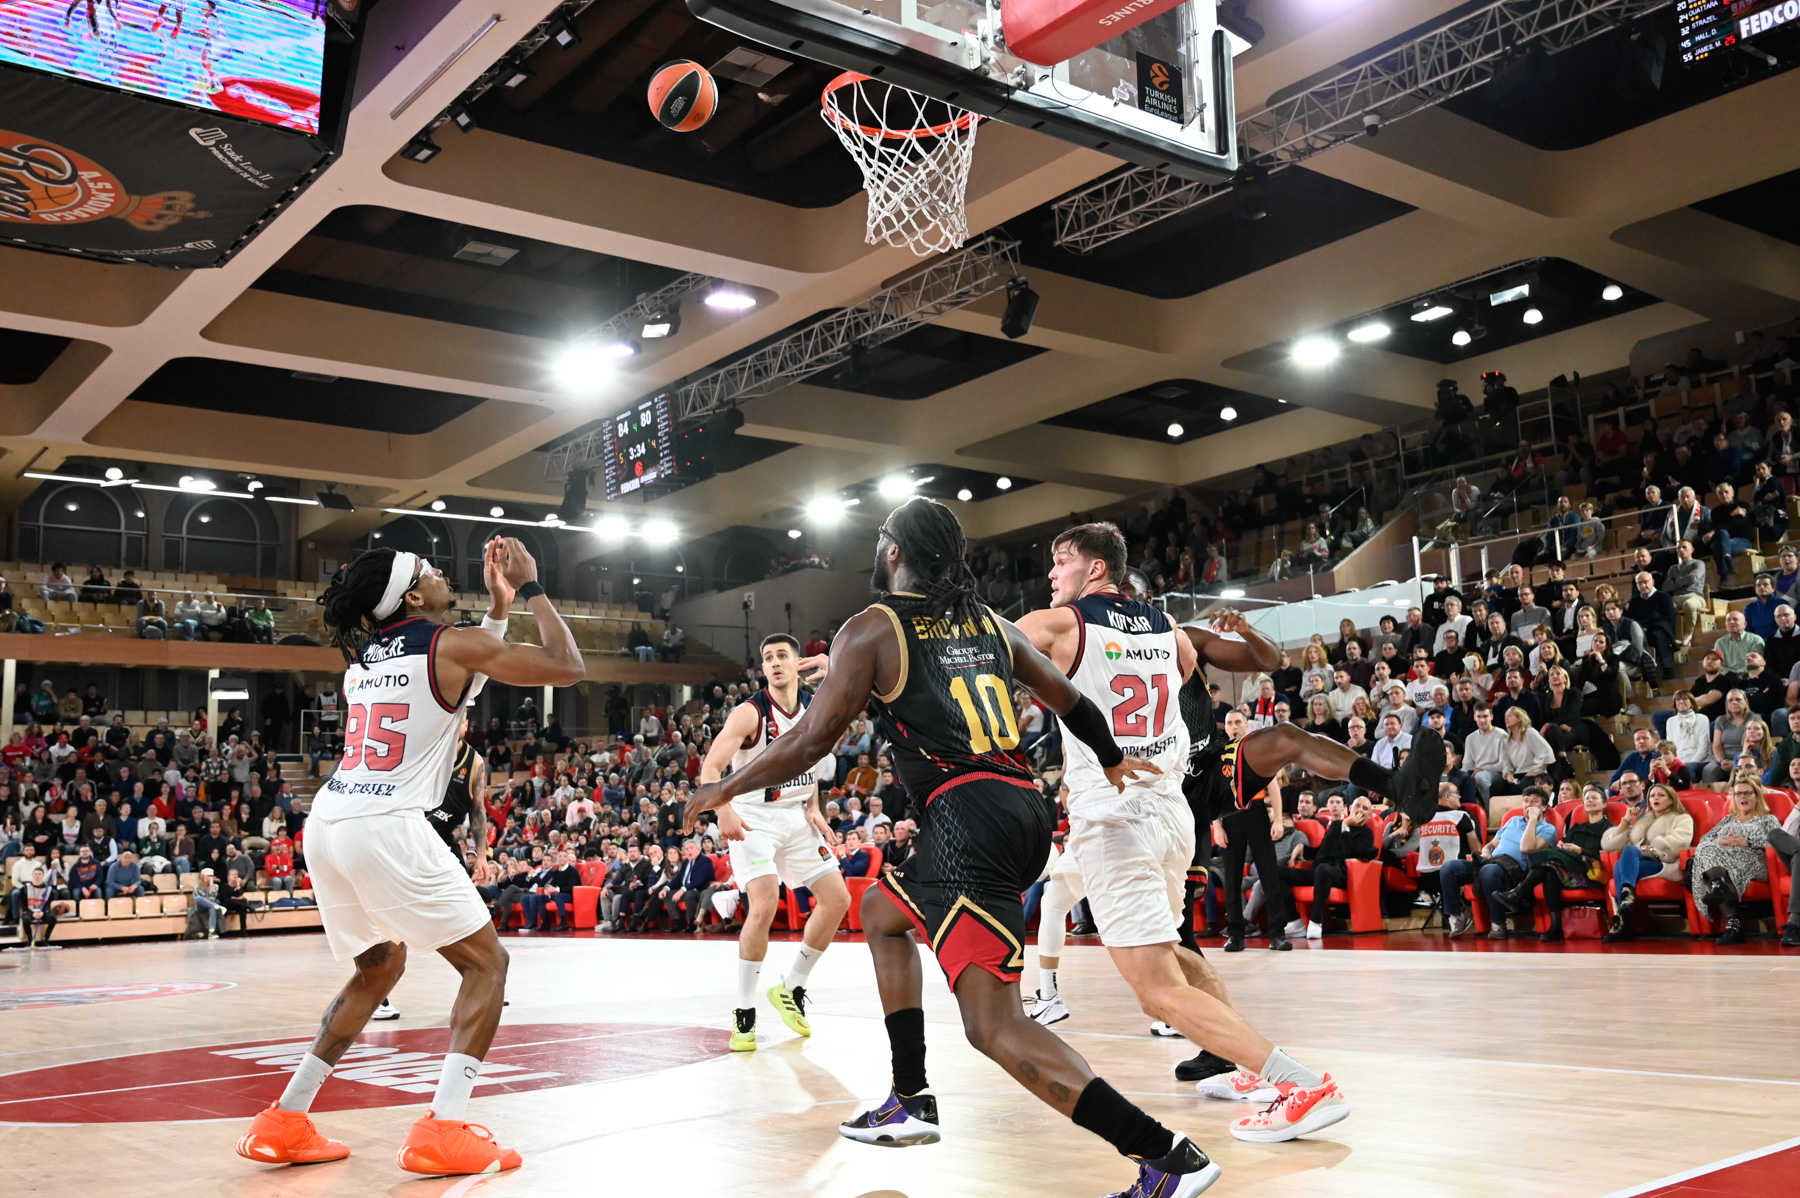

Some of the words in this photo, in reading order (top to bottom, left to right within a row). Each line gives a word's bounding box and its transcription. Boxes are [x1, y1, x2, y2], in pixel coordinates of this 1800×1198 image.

[1677, 1, 1687, 11] 20
[1678, 13, 1689, 23] 24
[1739, 0, 1800, 40] FEDCO
[1680, 26, 1690, 36] 32
[1681, 39, 1692, 48] 45
[1682, 52, 1693, 63] 55
[1724, 35, 1736, 46] 25
[1145, 86, 1177, 105] TURKISH
[1145, 96, 1178, 114] AIRLINES
[617, 420, 630, 438] 84
[640, 409, 652, 428] 80
[629, 441, 646, 460] 3:34
[1106, 610, 1153, 632] KOTSAR
[939, 655, 969, 665] MICHEL
[969, 652, 996, 663] PASTOR
[946, 645, 980, 656] GROUPE
[1125, 648, 1170, 661] AMUTIO
[357, 674, 410, 691] AMUTIO
[949, 673, 1021, 755] 10
[1109, 673, 1169, 737] 21
[340, 703, 410, 772] 95
